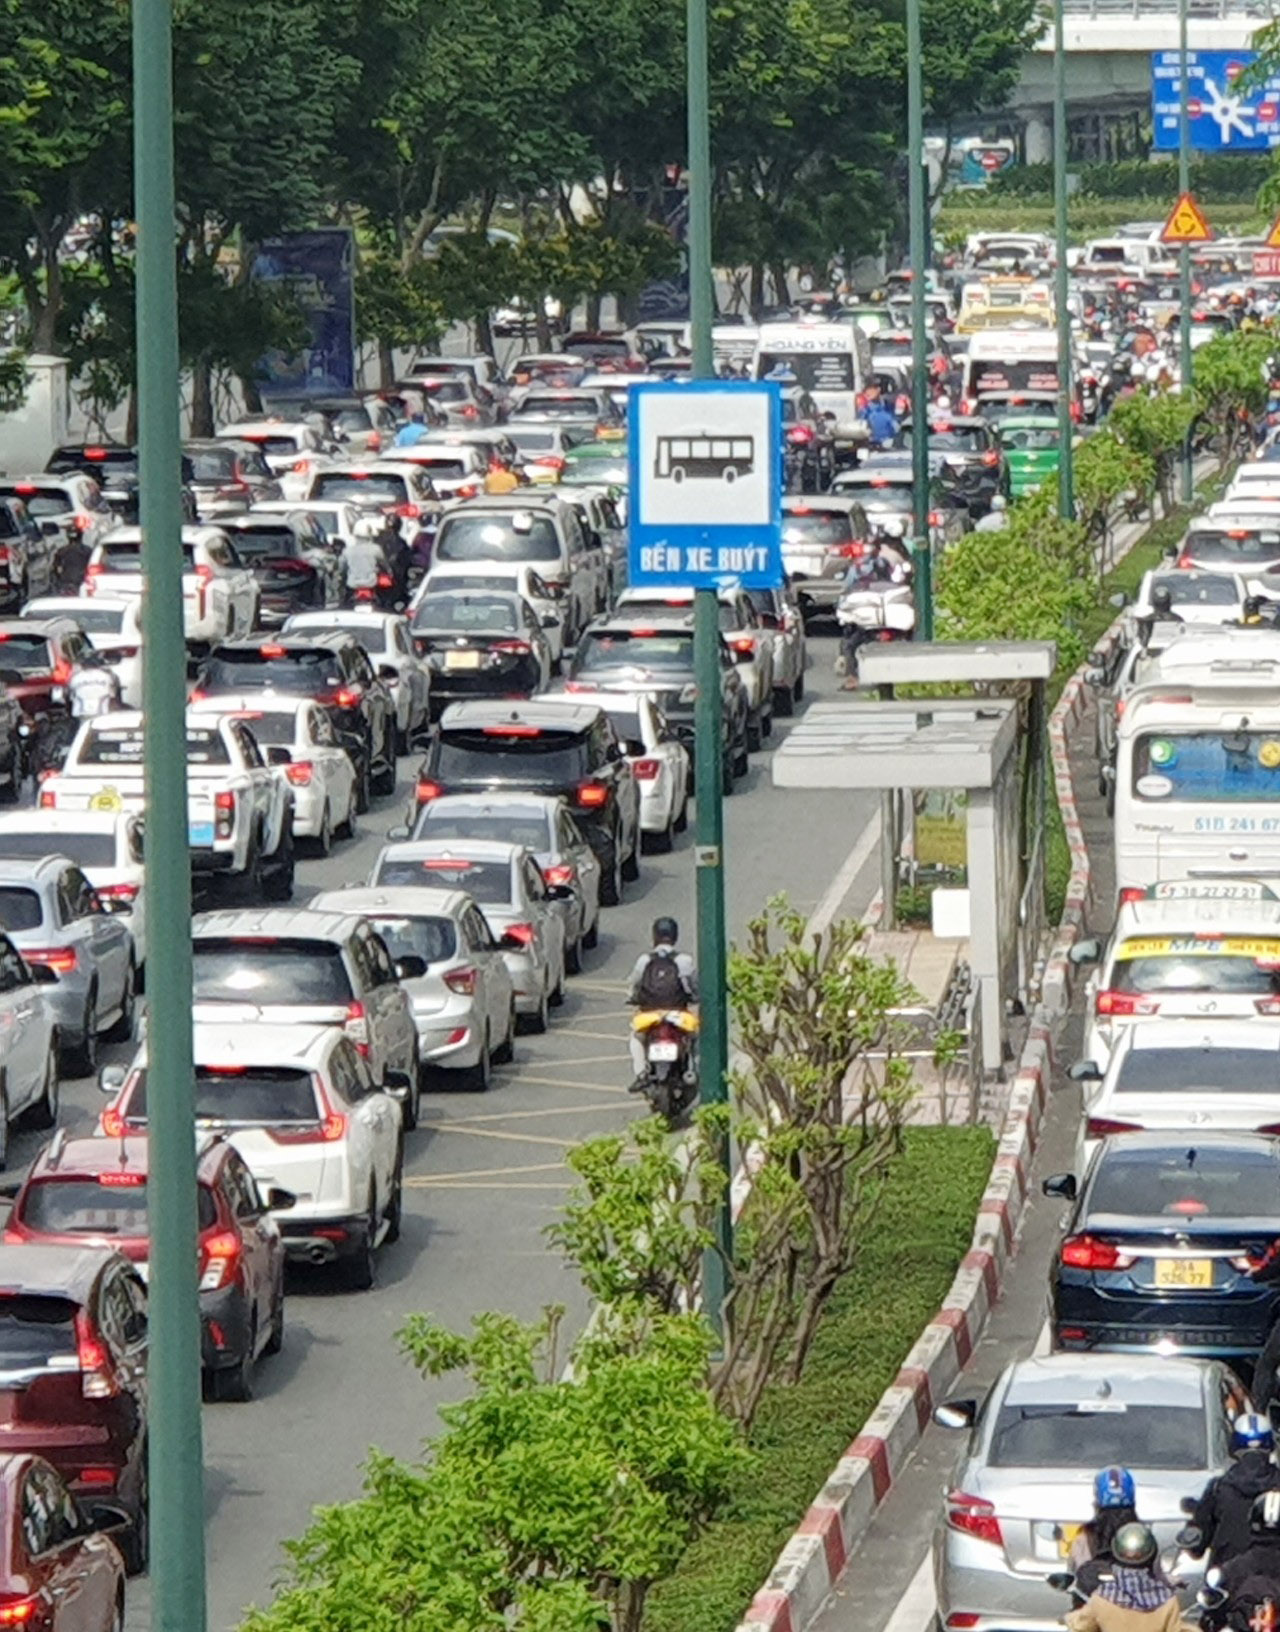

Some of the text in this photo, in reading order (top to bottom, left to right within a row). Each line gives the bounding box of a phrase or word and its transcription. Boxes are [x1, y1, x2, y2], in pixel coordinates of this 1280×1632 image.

[640, 539, 768, 573] BẾN XE BUÝT
